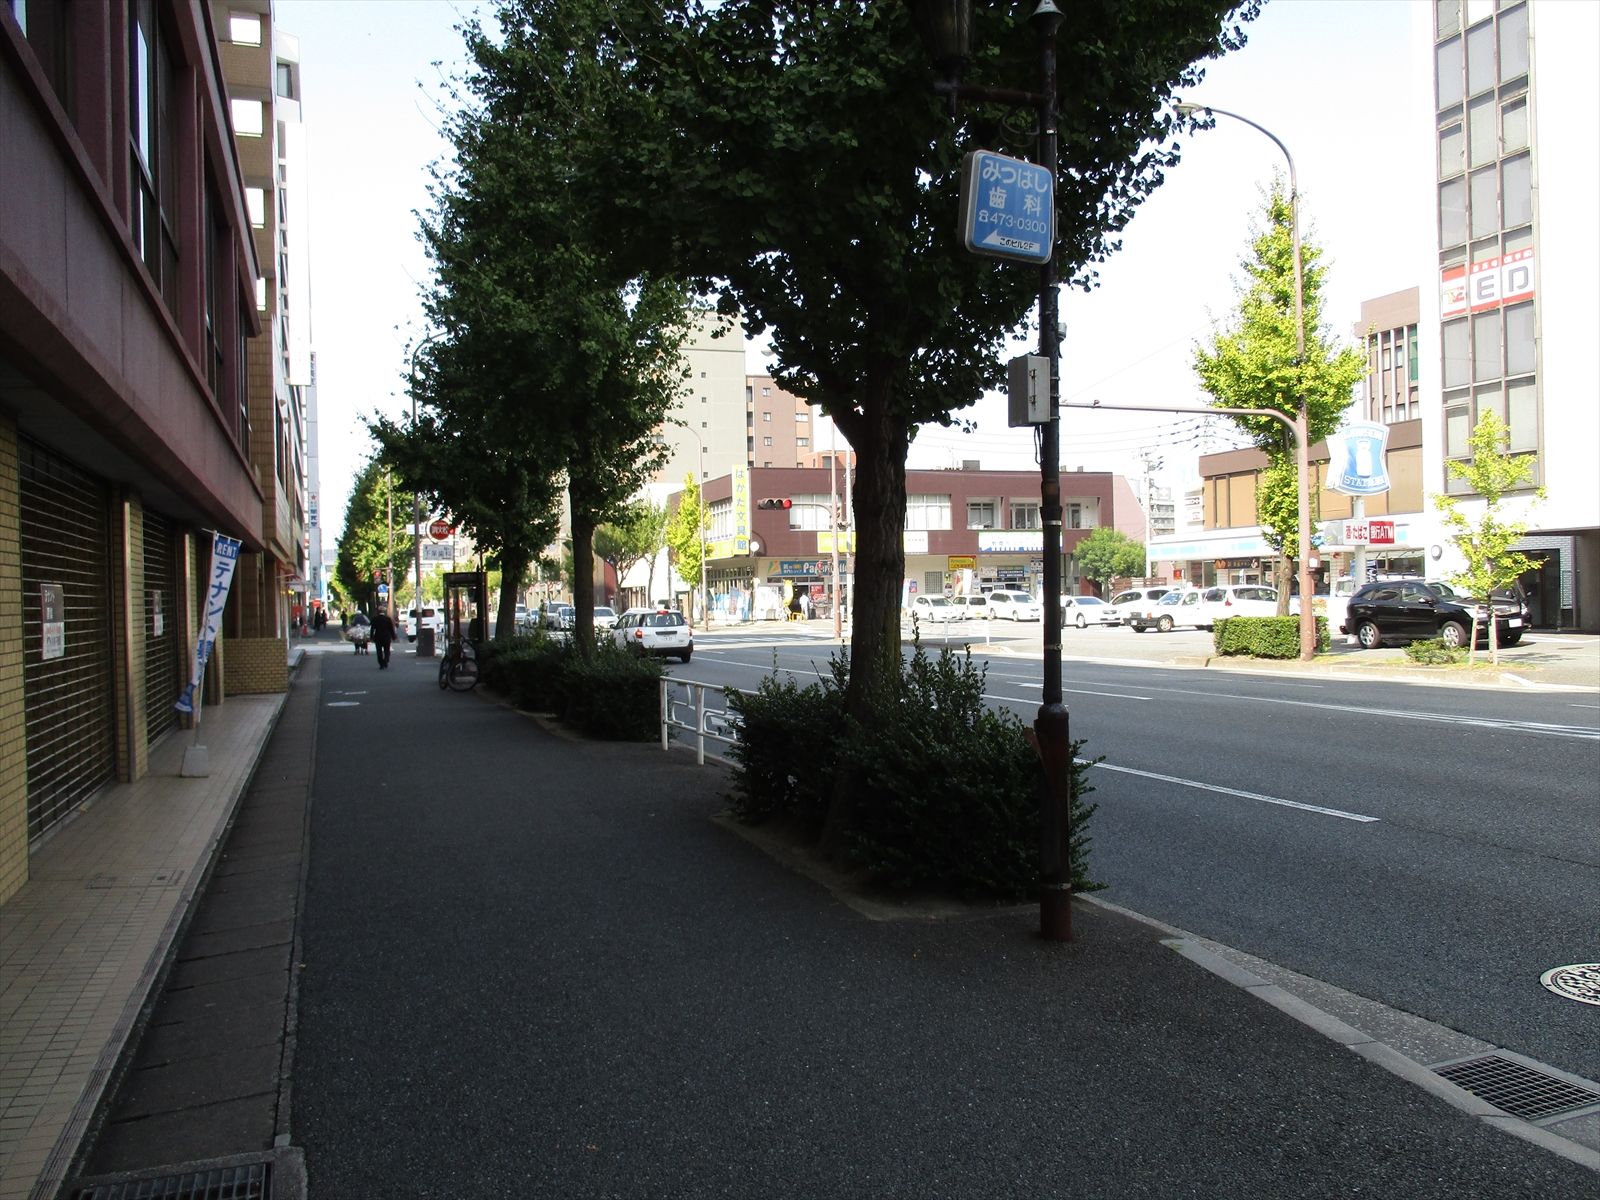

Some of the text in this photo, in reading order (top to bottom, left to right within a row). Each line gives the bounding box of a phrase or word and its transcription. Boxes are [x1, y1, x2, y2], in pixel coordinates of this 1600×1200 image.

[982, 159, 1048, 193] みつはし
[988, 186, 1042, 217] 歯科
[999, 238, 1034, 251] このビル2F
[216, 542, 237, 558] RENT
